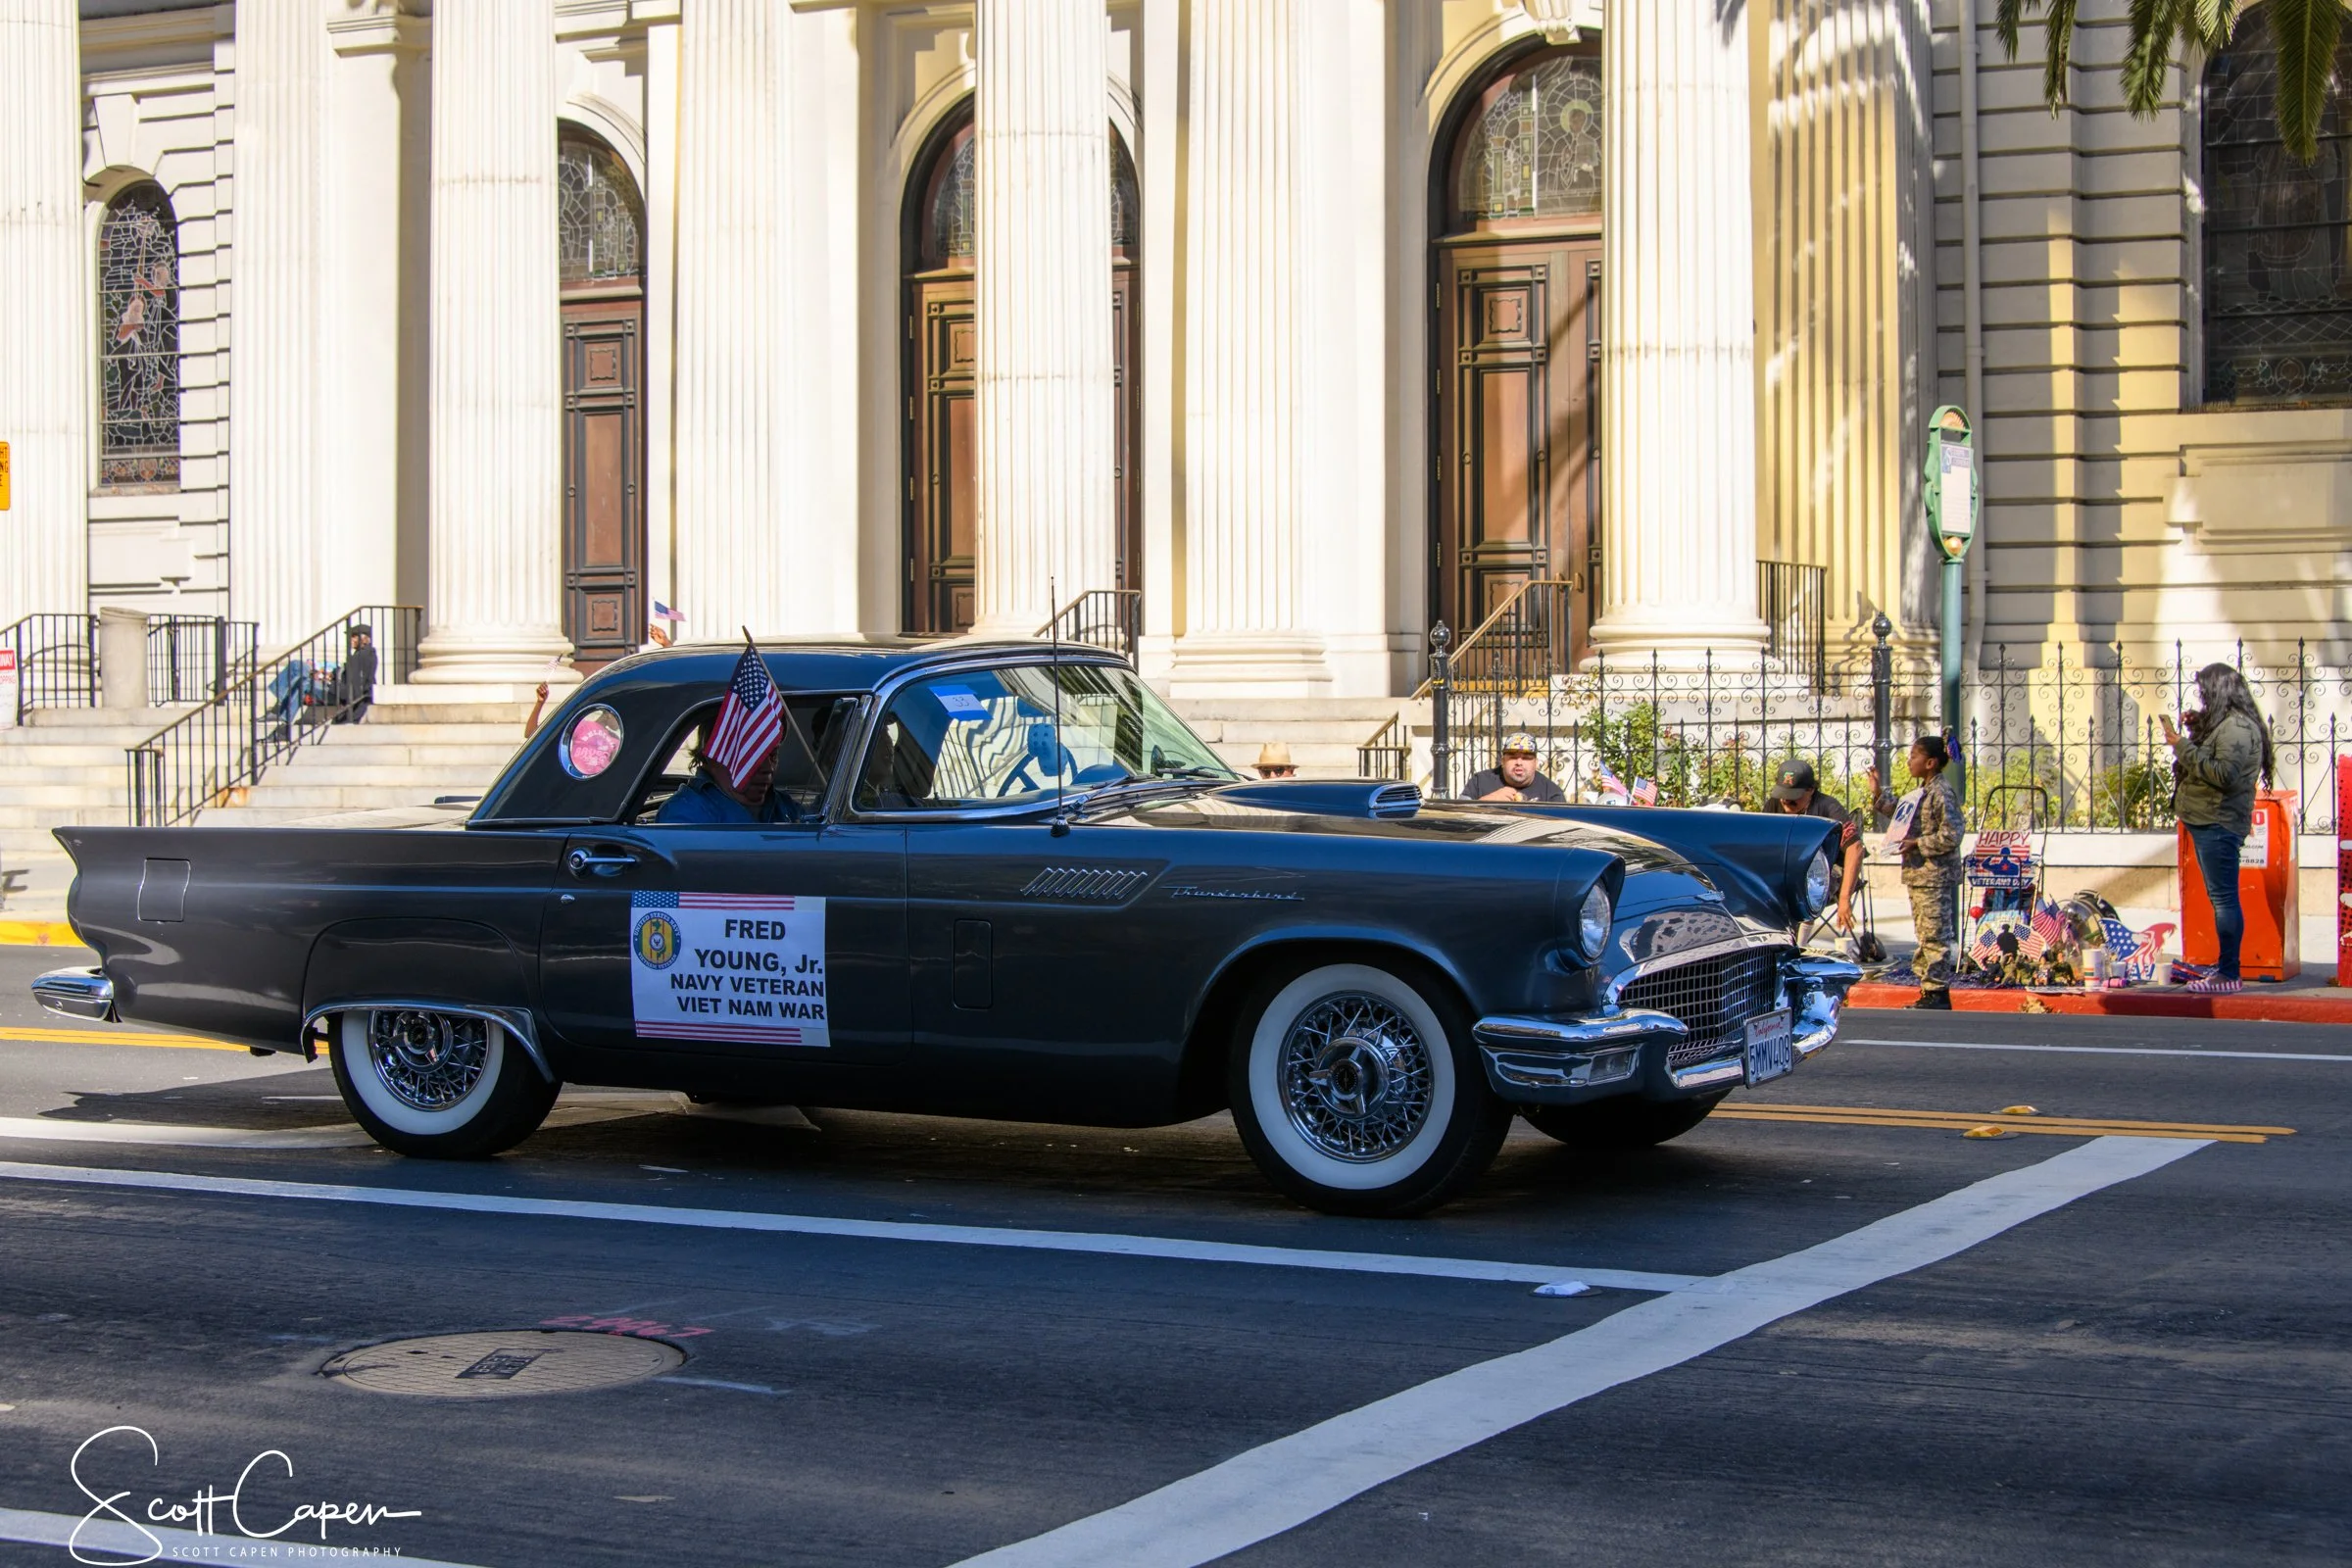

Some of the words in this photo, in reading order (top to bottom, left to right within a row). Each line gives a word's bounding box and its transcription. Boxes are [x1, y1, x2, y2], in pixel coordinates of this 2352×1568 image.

[1979, 831, 2031, 845] HAPPY
[1159, 886, 1304, 901] Thunderbird
[634, 913, 650, 936] UNITED
[649, 911, 670, 922] STATES
[669, 919, 682, 937] NAVY
[725, 918, 786, 941] FRED
[695, 949, 787, 977] YOUNG,
[795, 955, 823, 974] Jr.
[670, 973, 723, 992] NAVY
[730, 976, 824, 998] VETERAN
[676, 996, 722, 1014] VIET
[728, 1001, 772, 1018] NAM
[778, 1002, 825, 1021] WAR
[1748, 1034, 1790, 1076] 5MMV408
